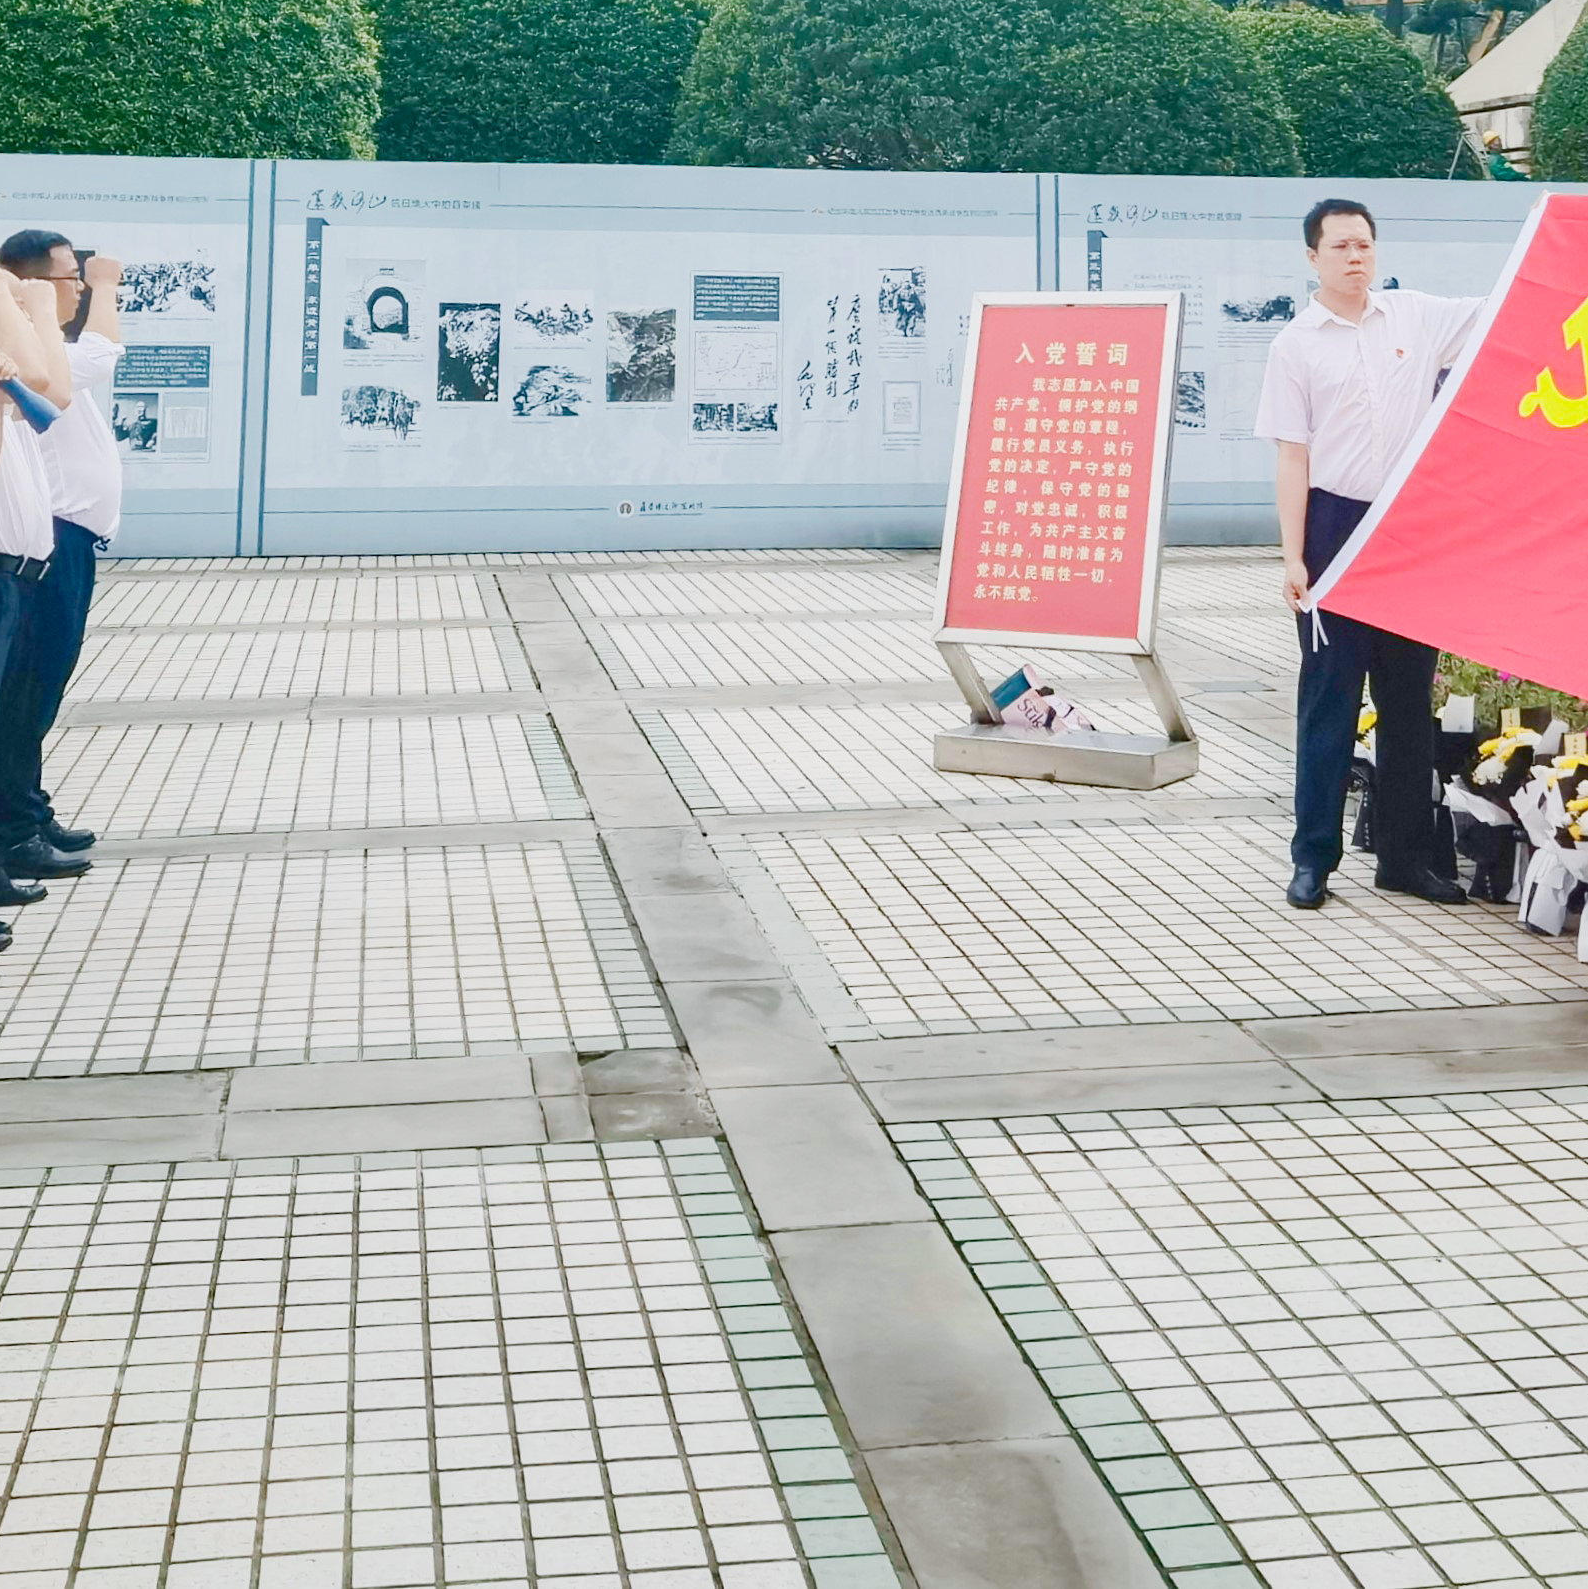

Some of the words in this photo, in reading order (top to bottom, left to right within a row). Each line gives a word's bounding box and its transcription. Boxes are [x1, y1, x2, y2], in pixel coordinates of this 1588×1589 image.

[1015, 342, 1128, 366] 入党誓词
[1032, 377, 1140, 394] 我志愿加入中国
[995, 397, 1138, 414] 共产党，拥护党的纲
[990, 438, 1134, 456] 履行党员义务，执行
[988, 458, 1132, 477] 党的决定，严守党的
[985, 478, 1130, 498] 纪律，保守党的秘
[983, 499, 1128, 519] 密，对党忠诚，积极
[981, 521, 1126, 540] 工作，为共产主义奋
[979, 542, 1123, 562] 斗终身，随时准备为
[973, 585, 1038, 603] 永不叛党。
